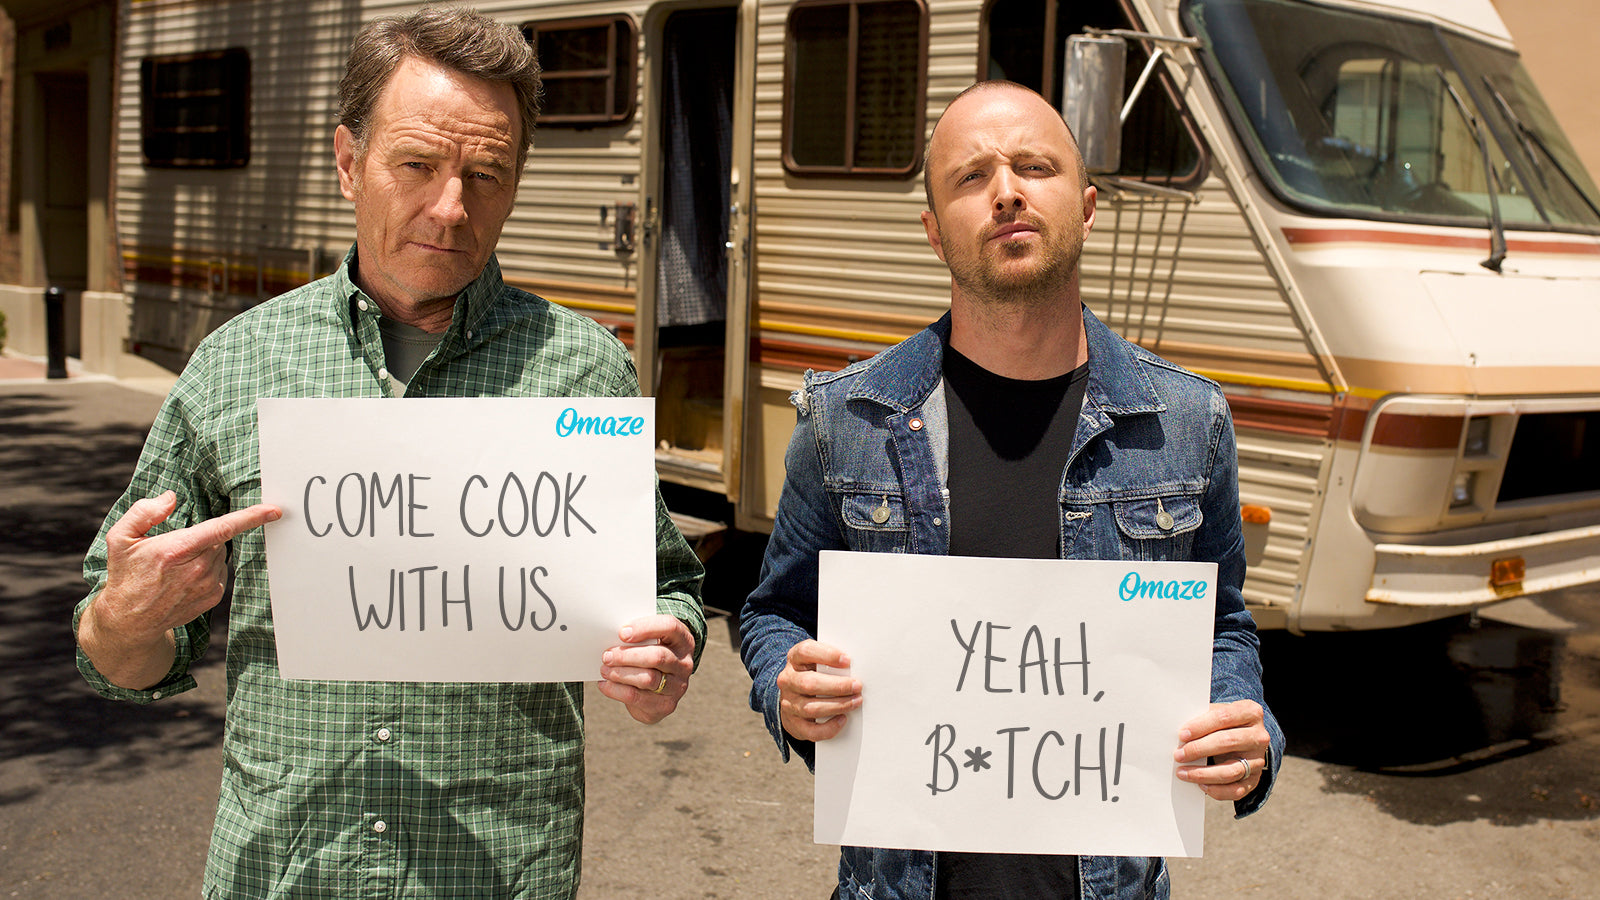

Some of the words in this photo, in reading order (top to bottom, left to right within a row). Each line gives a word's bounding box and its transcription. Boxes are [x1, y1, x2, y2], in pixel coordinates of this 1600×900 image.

[555, 407, 645, 438] Omaze
[303, 472, 435, 538] COME
[459, 471, 597, 538] COOK
[348, 564, 473, 632] WITH
[498, 566, 568, 632] US.
[1118, 571, 1208, 602] Omaze
[950, 618, 1105, 702] YEAH,
